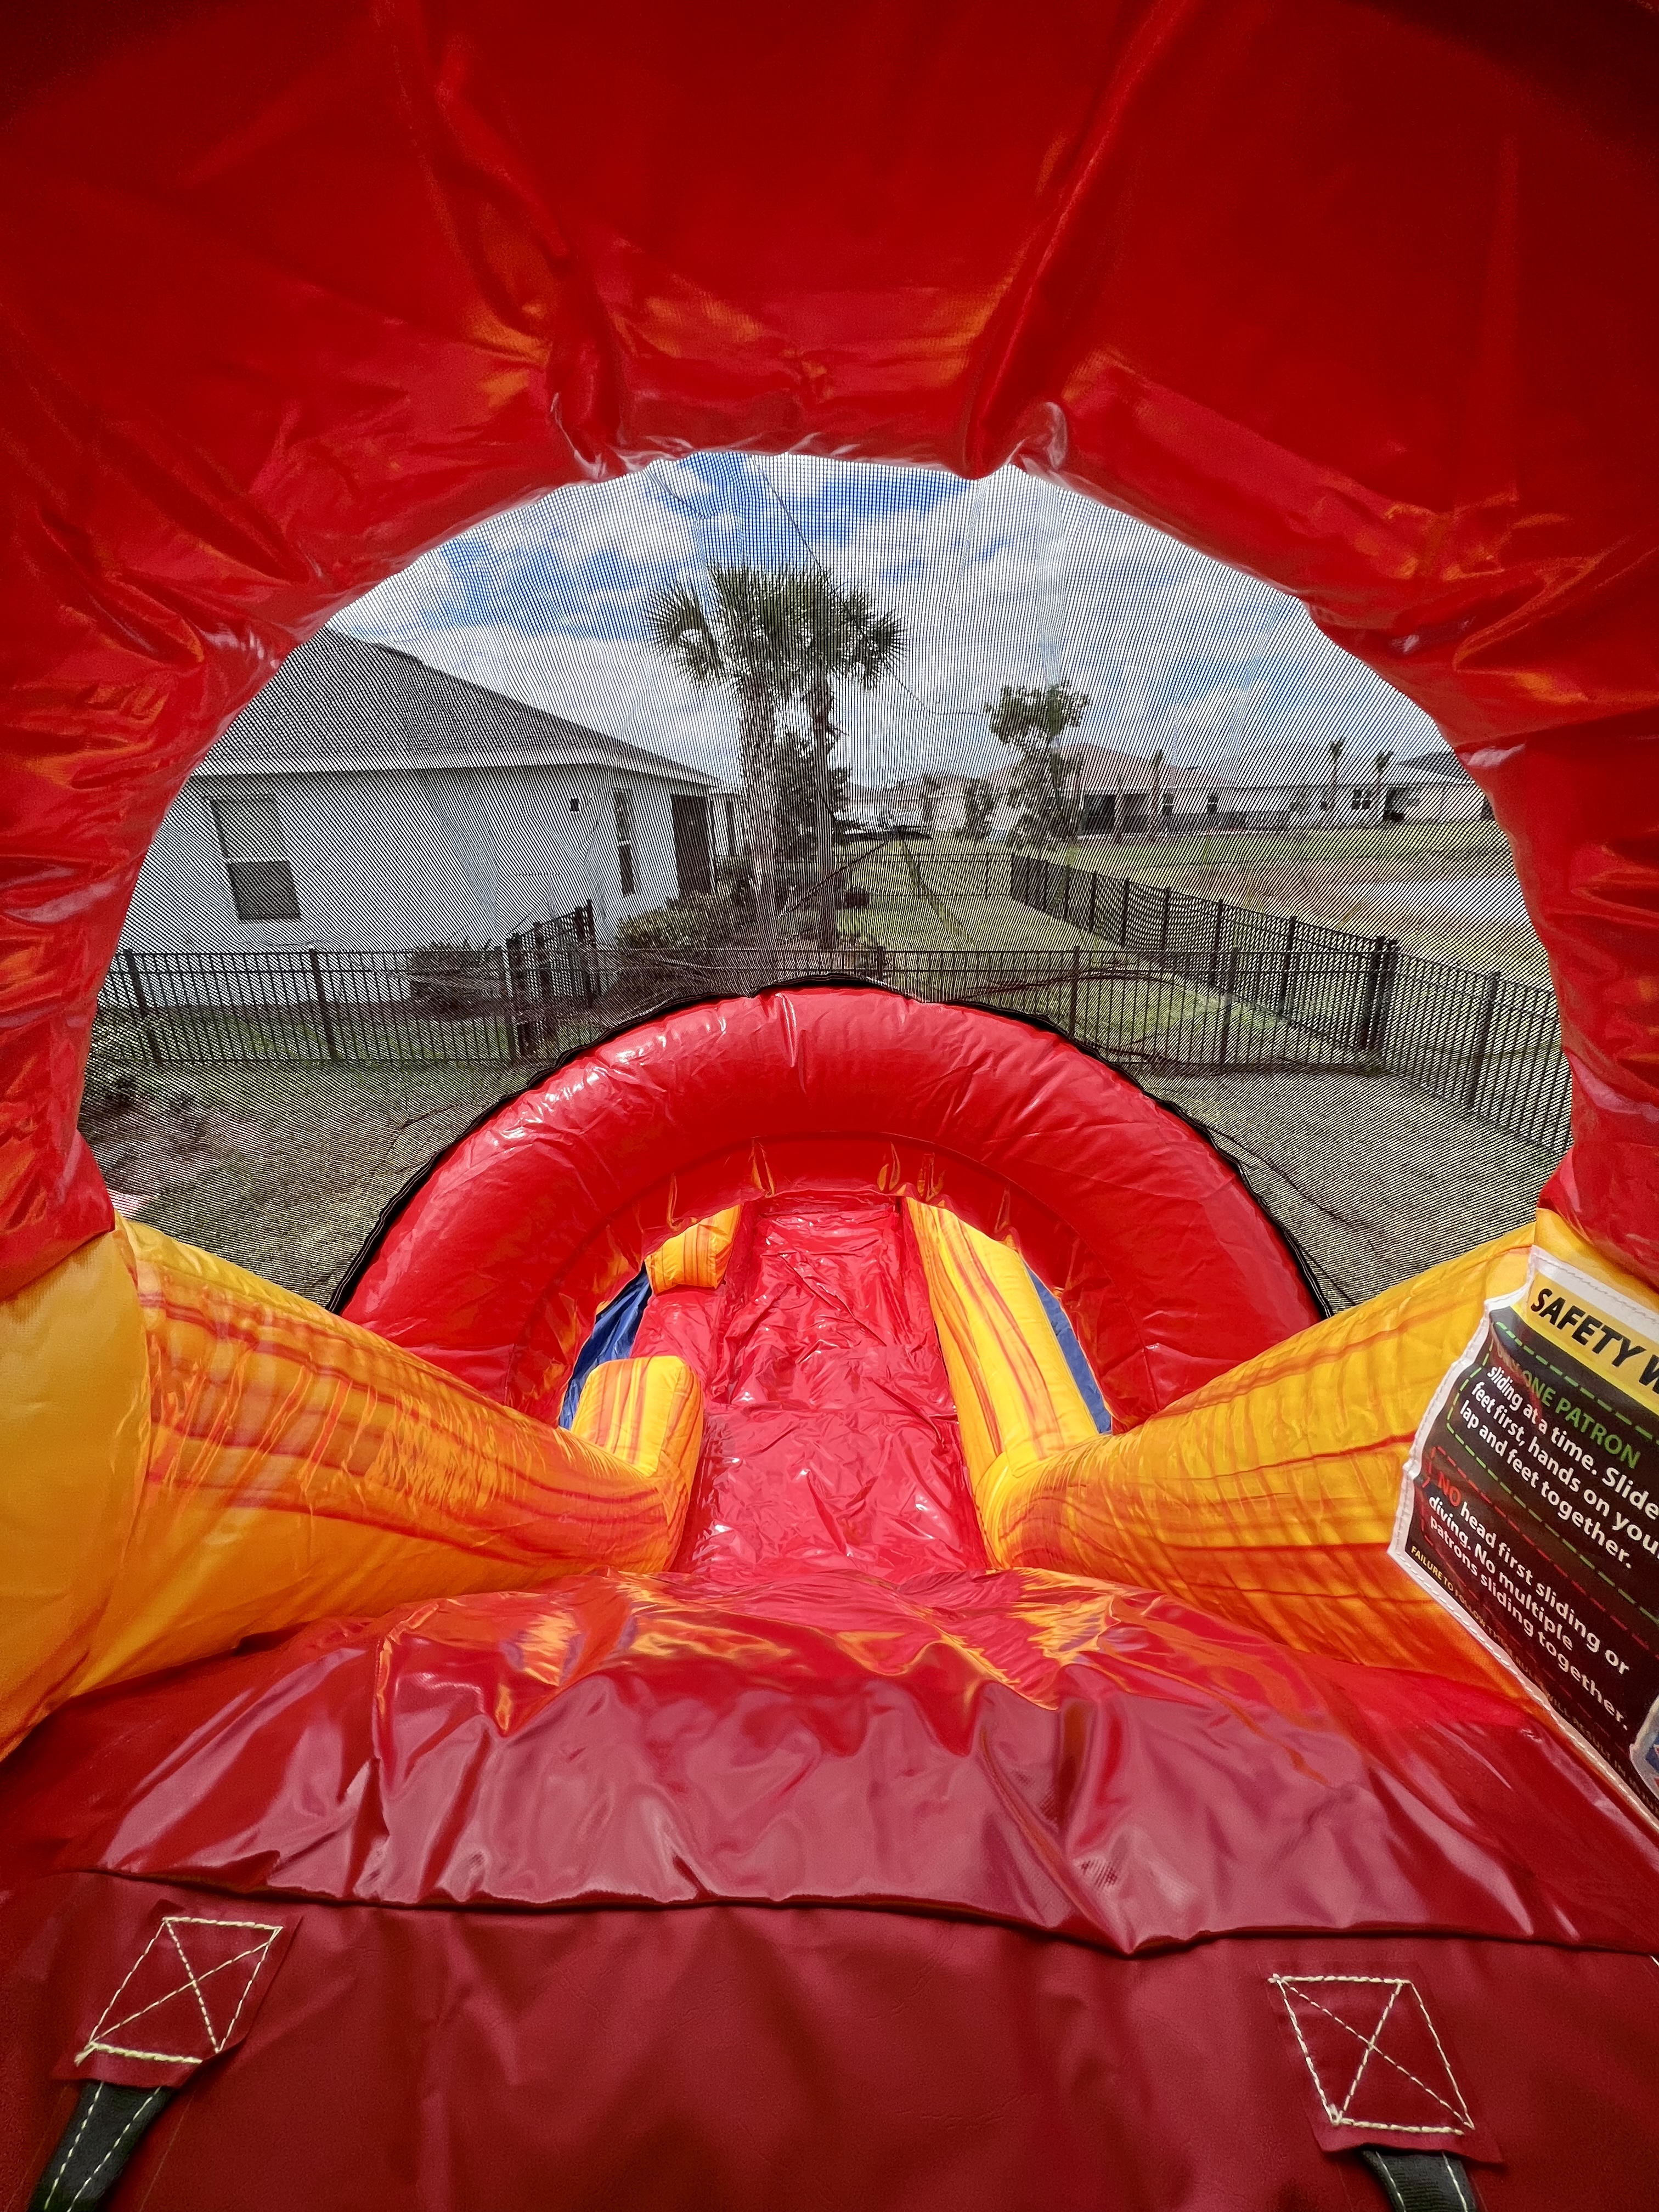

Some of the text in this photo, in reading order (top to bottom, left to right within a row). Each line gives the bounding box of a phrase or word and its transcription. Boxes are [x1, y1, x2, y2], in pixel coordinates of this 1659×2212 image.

[1531, 1288, 1647, 1367] SAFETY
[1460, 1400, 1632, 1569] lap and feet together.
[1471, 1381, 1659, 1559] feet first, hands on you
[1487, 1367, 1659, 1520] sliding at a time. Slide
[1522, 1370, 1641, 1469] ONE PATRON
[1411, 1545, 1442, 1581] FAILURE
[1443, 1577, 1454, 1592] TO
[1429, 1497, 1471, 1550] diving.
[1475, 1543, 1496, 1574] No
[1499, 1572, 1573, 1651] multiple
[1430, 1515, 1478, 1576] patrons
[1481, 1574, 1534, 1637] sliding
[1538, 1632, 1628, 1731] together.
[1438, 1471, 1462, 1507] NO
[1460, 1501, 1497, 1549] head
[1498, 1542, 1533, 1585] first
[1536, 1583, 1600, 1653] sliding
[1605, 1650, 1630, 1674] or
